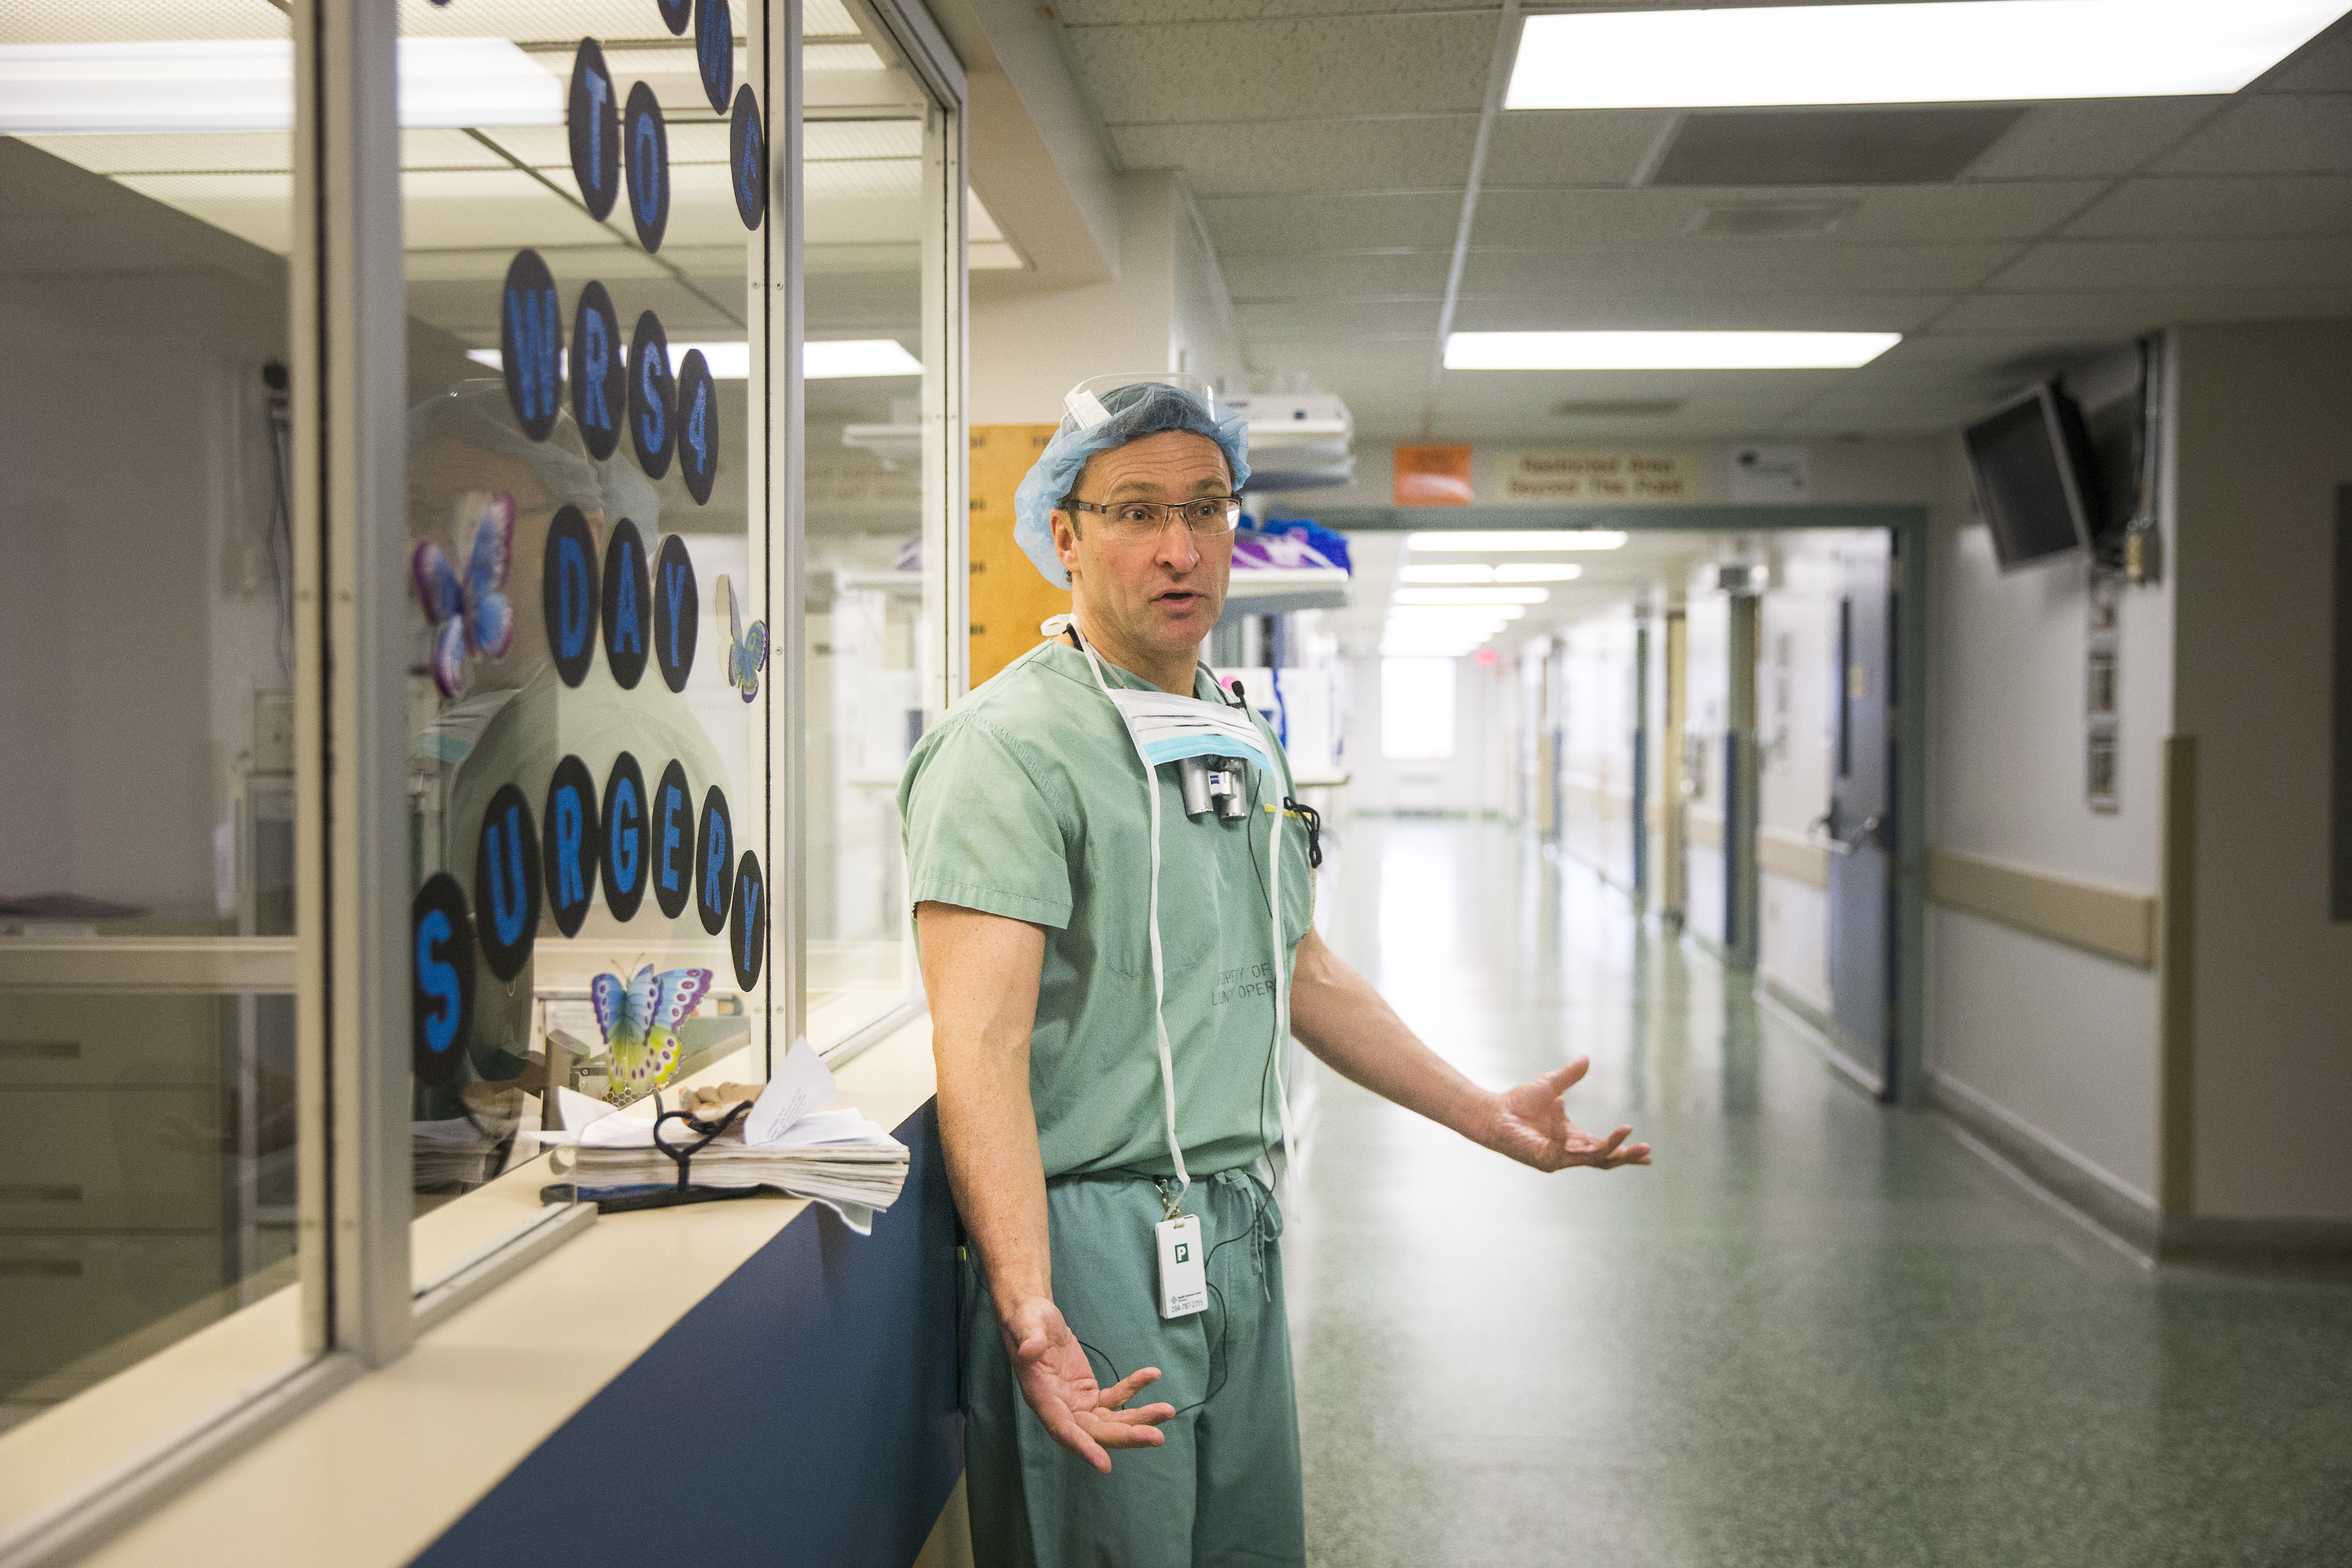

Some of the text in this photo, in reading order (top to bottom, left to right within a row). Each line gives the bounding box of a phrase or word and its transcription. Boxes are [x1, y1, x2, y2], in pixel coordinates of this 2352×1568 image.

[585, 66, 659, 227] TO
[559, 537, 686, 667] DAY
[416, 777, 760, 1054] SURGERY
[1251, 962, 1271, 978] OF
[1176, 1246, 1186, 1262] P
